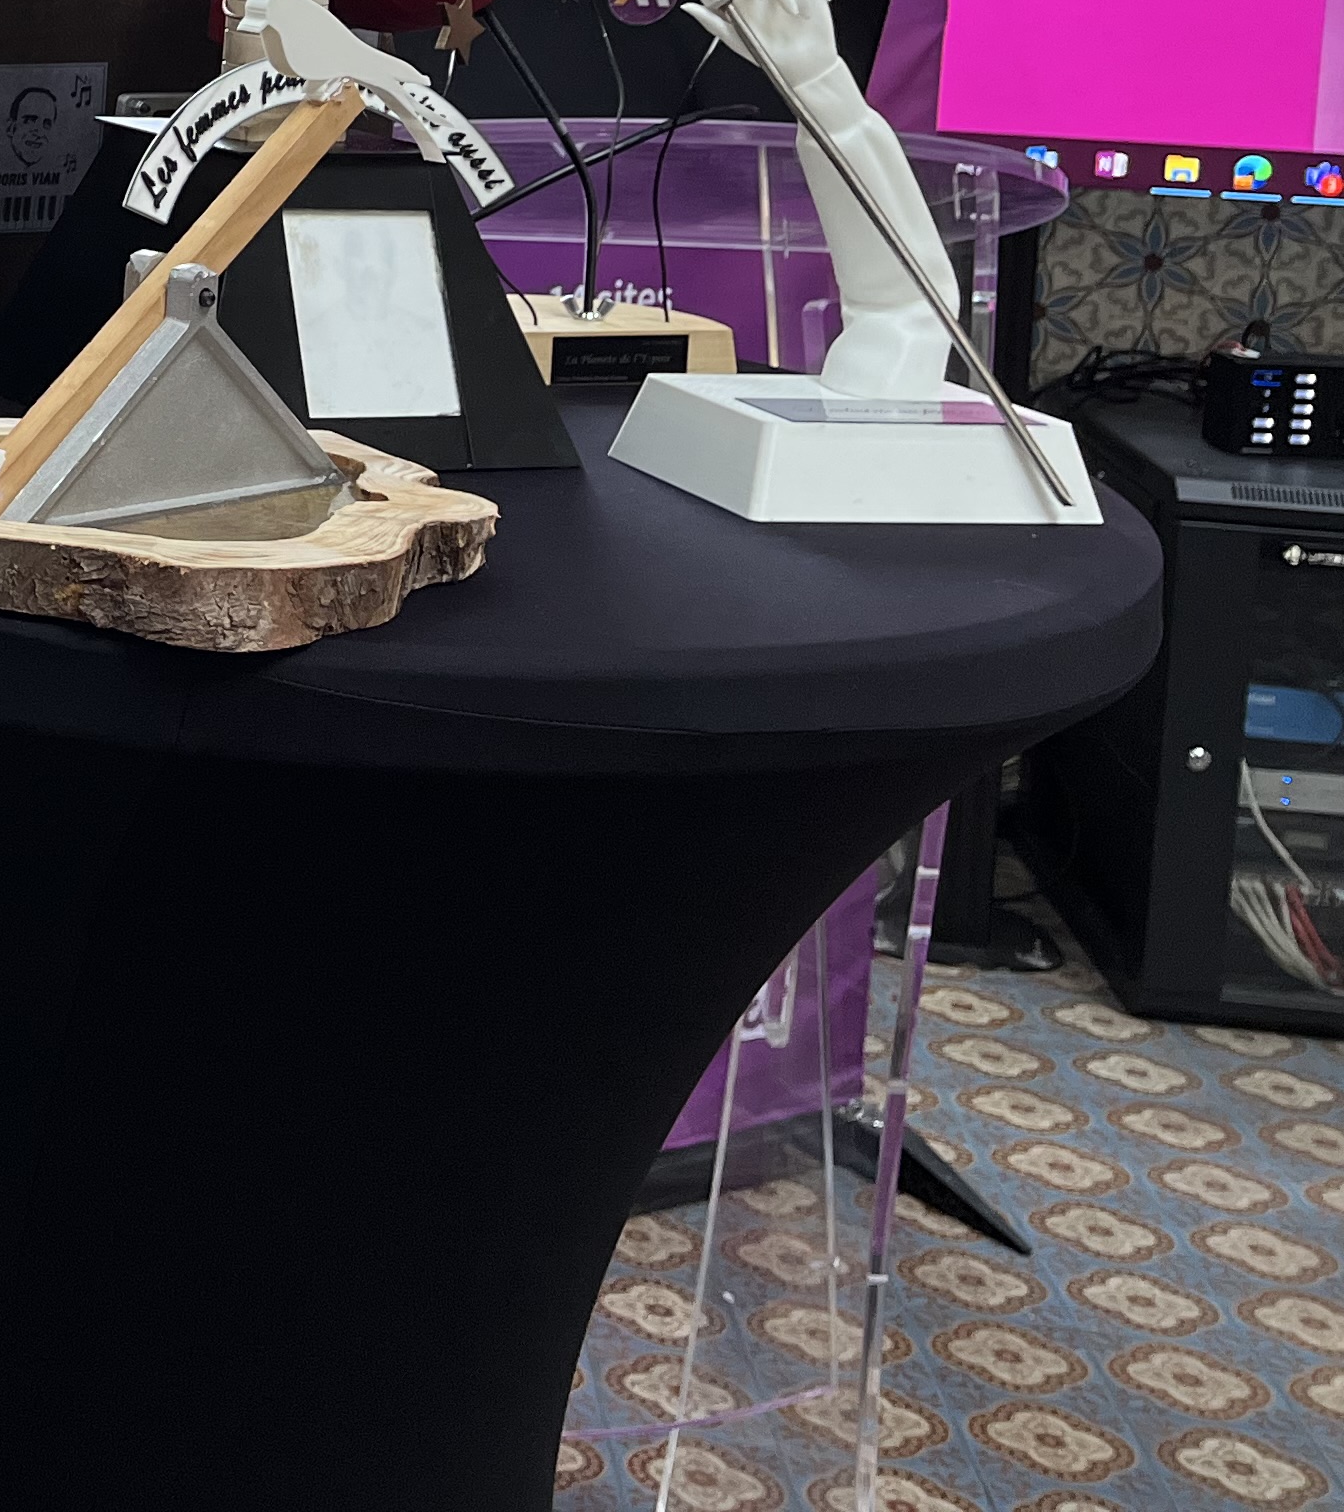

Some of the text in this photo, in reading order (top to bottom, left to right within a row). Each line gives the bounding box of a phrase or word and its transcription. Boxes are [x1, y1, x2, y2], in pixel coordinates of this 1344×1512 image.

[31, 171, 61, 186] VIAN
[140, 155, 178, 209] Les
[173, 83, 251, 162] femmes
